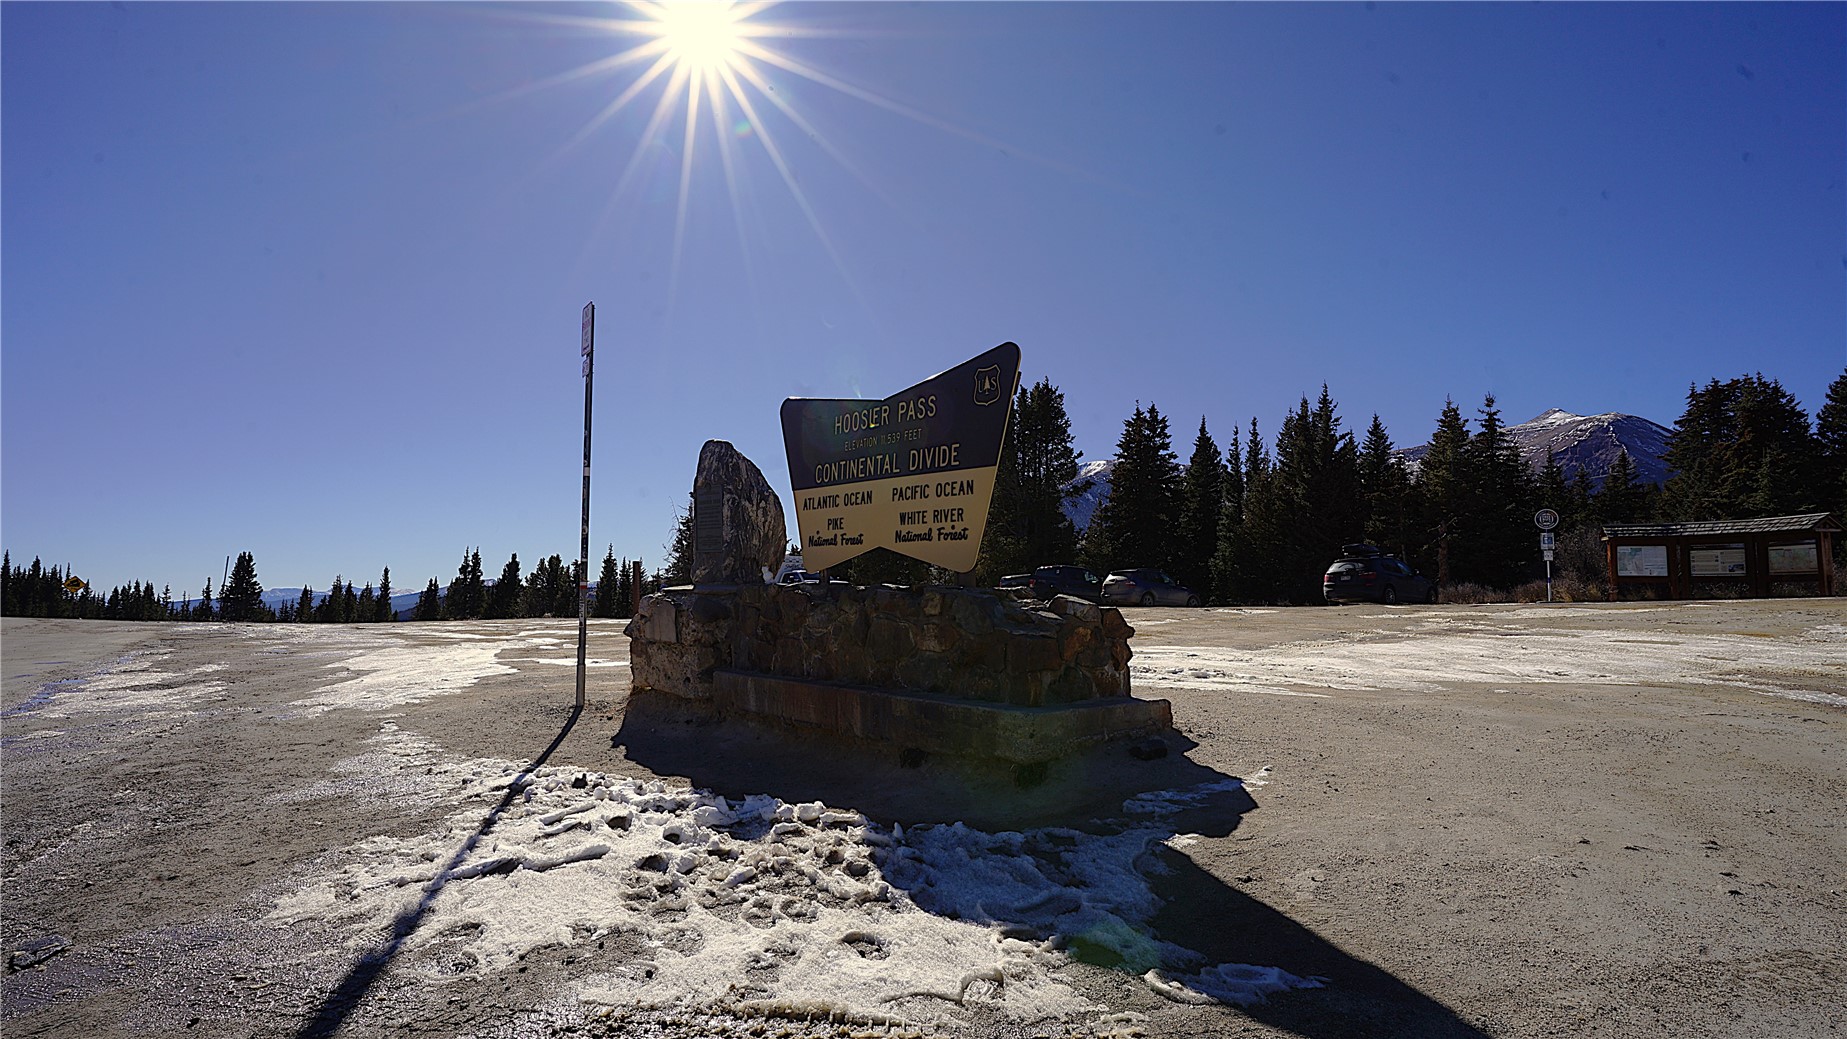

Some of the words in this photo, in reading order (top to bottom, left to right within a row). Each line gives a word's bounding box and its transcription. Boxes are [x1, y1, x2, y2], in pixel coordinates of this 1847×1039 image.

[834, 405, 890, 435] HOOSIER
[898, 395, 936, 423] PASS
[844, 436, 878, 452] ELEVATION
[904, 428, 922, 440] FEET
[815, 453, 900, 484] CONTINENTAL
[909, 443, 960, 471] DIVIDE
[803, 493, 840, 511] ATLANTIC
[843, 490, 873, 507] OCEAN
[891, 484, 930, 502] PACIFIC
[935, 479, 974, 498] OCEAN
[827, 517, 845, 531] PIKE
[899, 510, 928, 526] WHITE
[933, 507, 964, 524] RIVER
[808, 533, 838, 548] National
[840, 532, 864, 546] Forest
[895, 527, 933, 544] National
[937, 526, 969, 542] Forest
